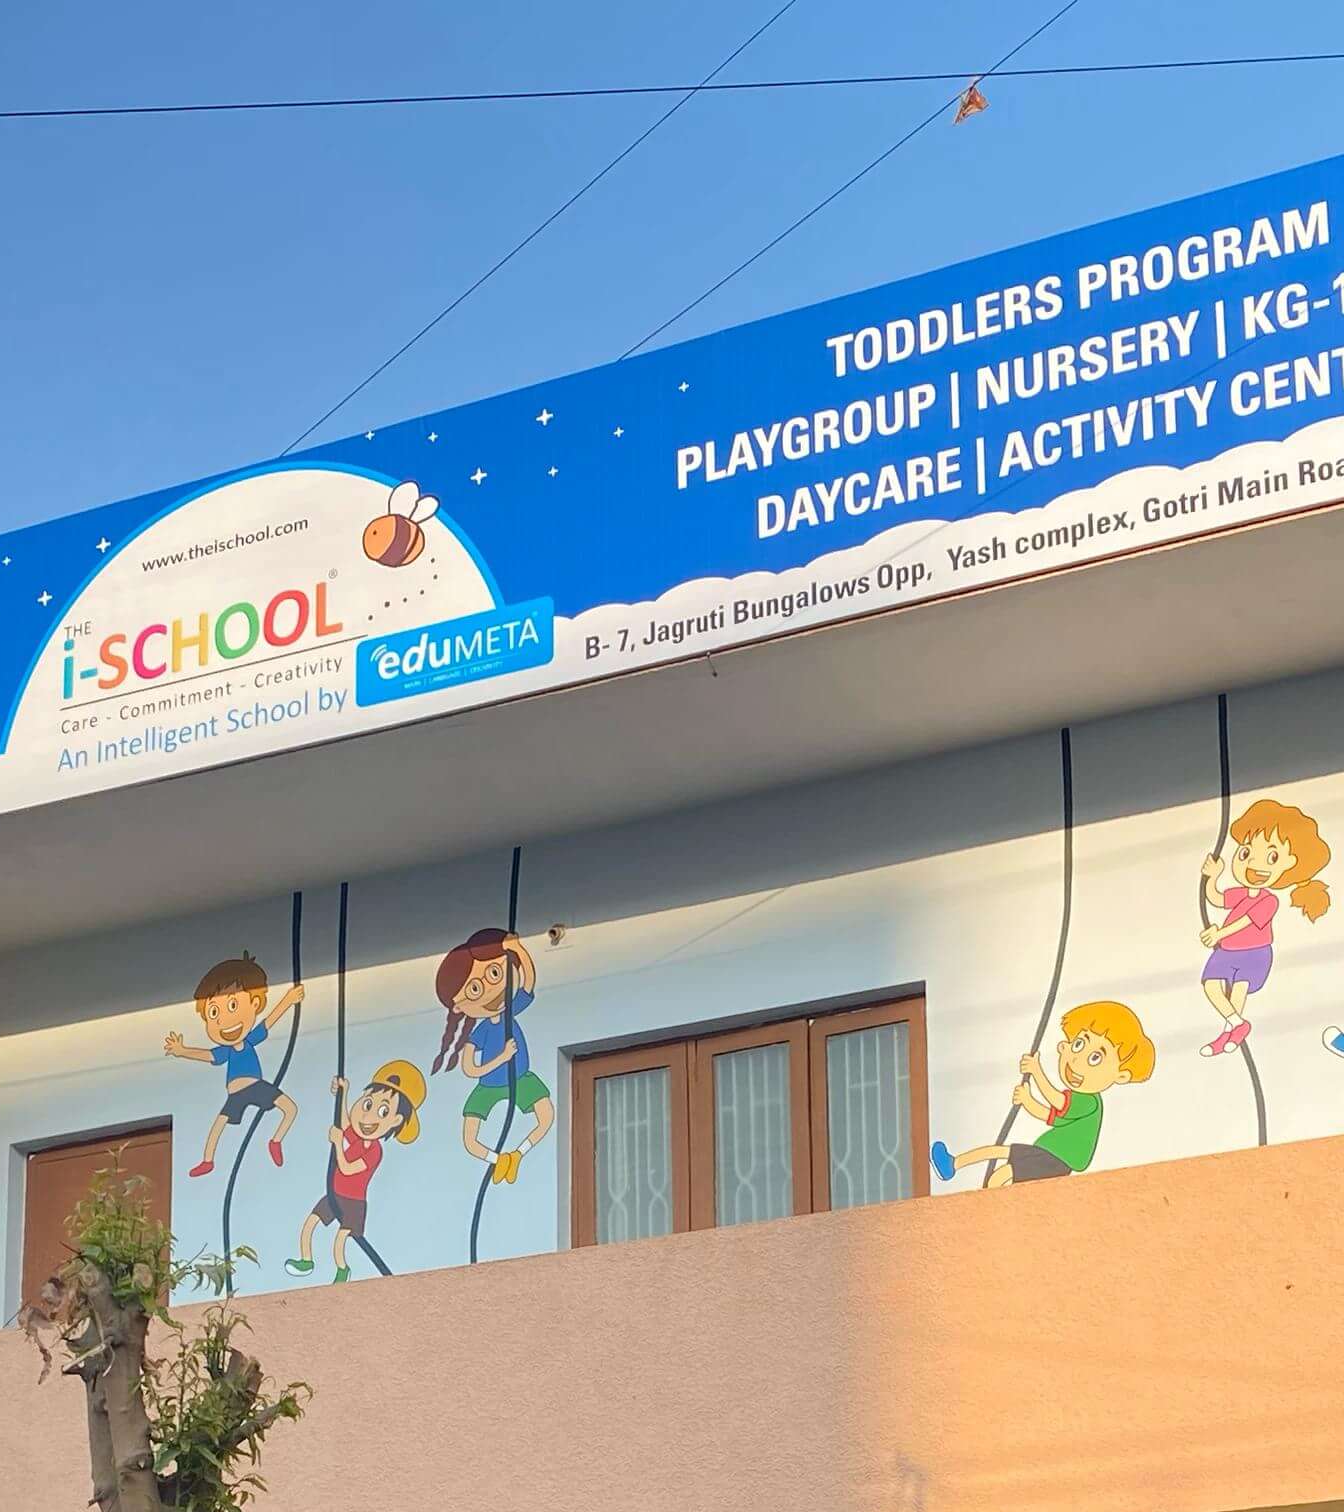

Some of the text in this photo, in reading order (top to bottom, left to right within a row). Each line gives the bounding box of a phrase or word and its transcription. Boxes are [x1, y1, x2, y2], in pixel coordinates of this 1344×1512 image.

[826, 200, 1330, 378] TODDLERS PROGRAM
[677, 382, 936, 490] PLAYGROUP
[976, 311, 1201, 411] NURSERY
[757, 447, 962, 540] DAYCARE
[998, 380, 1217, 478] ACTIVITY
[585, 635, 611, 660] B-
[617, 628, 636, 655] 7,
[642, 604, 726, 647] Jagruti
[733, 573, 870, 626] Bungalows
[876, 560, 934, 592] Opp,
[946, 536, 1007, 571] Yash
[1015, 510, 1136, 556] complex,
[1143, 484, 1208, 523] Gotri
[1218, 469, 1289, 507] Main
[63, 581, 344, 700] i-SCHOOL
[64, 621, 92, 639] THE
[376, 617, 540, 680] eduMETA
[57, 686, 349, 772] An Intelligent School by
[60, 656, 344, 735] Care Commitment Creativity
